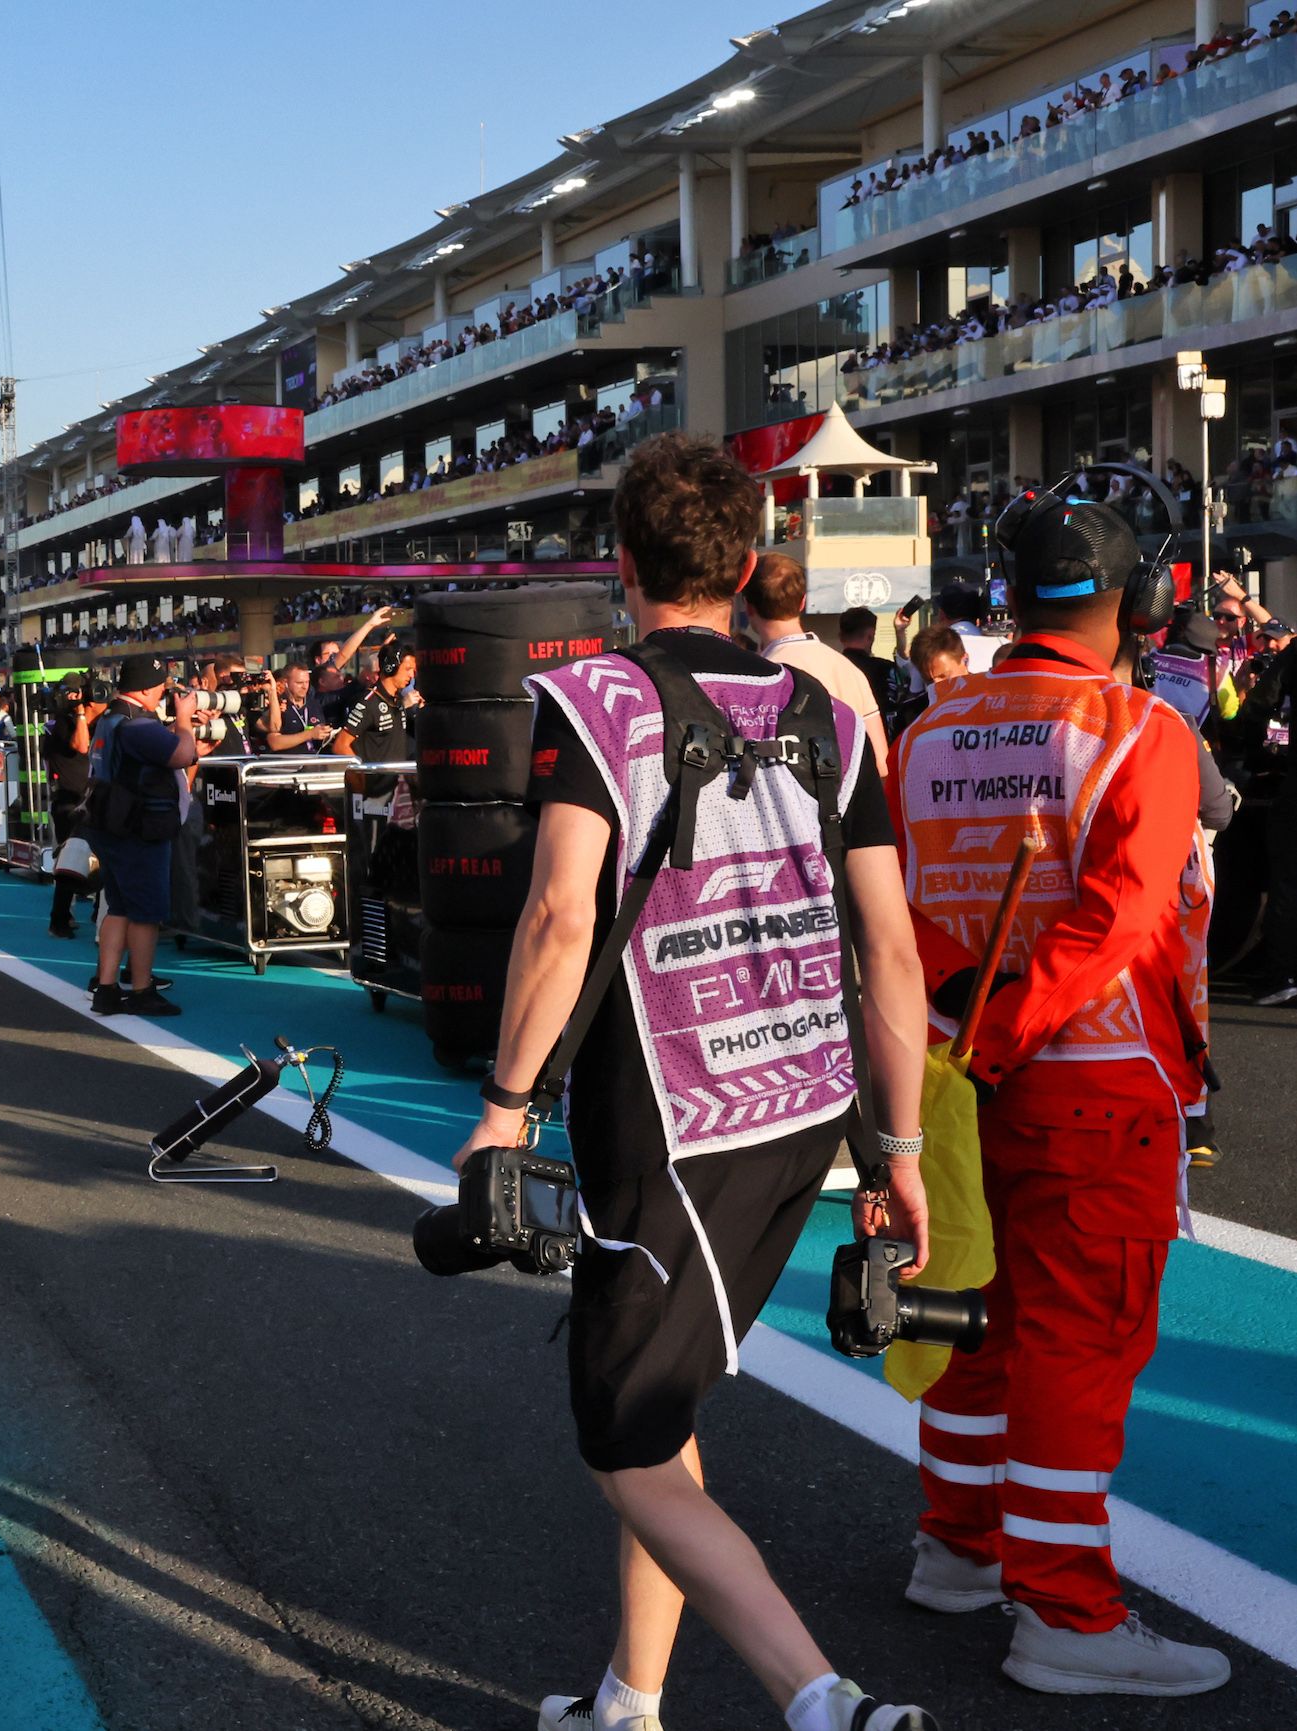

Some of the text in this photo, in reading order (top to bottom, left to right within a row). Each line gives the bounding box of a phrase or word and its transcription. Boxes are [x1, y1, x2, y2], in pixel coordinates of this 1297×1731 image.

[528, 638, 604, 659] LEFT FRONT
[449, 749, 489, 765] FRONT
[931, 774, 1066, 802] PIT MARSHAL
[460, 857, 502, 876] REAR
[655, 922, 723, 963] ABU
